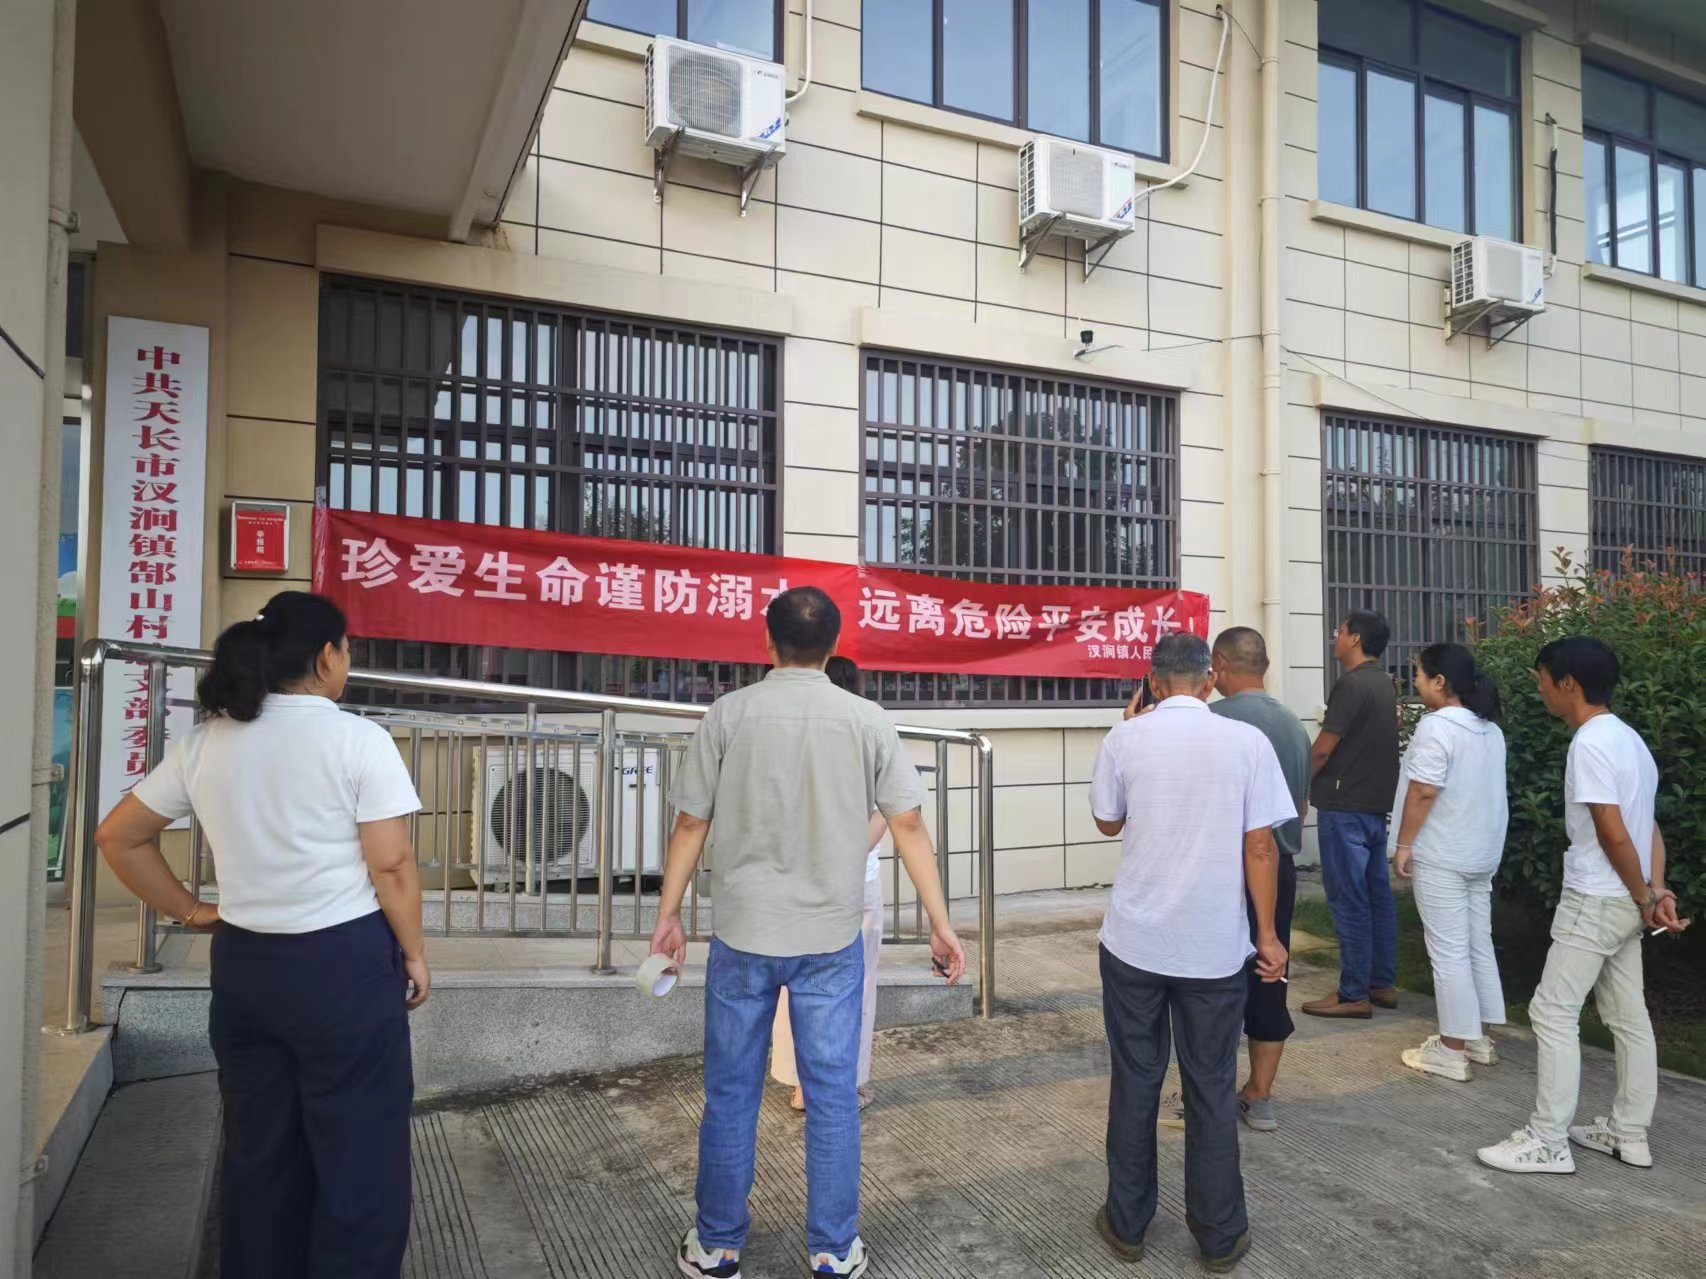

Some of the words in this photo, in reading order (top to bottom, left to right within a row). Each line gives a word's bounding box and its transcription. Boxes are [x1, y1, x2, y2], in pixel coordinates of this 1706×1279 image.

[121, 345, 182, 795] 中共天长市汊涧镇郜山村支部委
[622, 766, 654, 775] GRE
